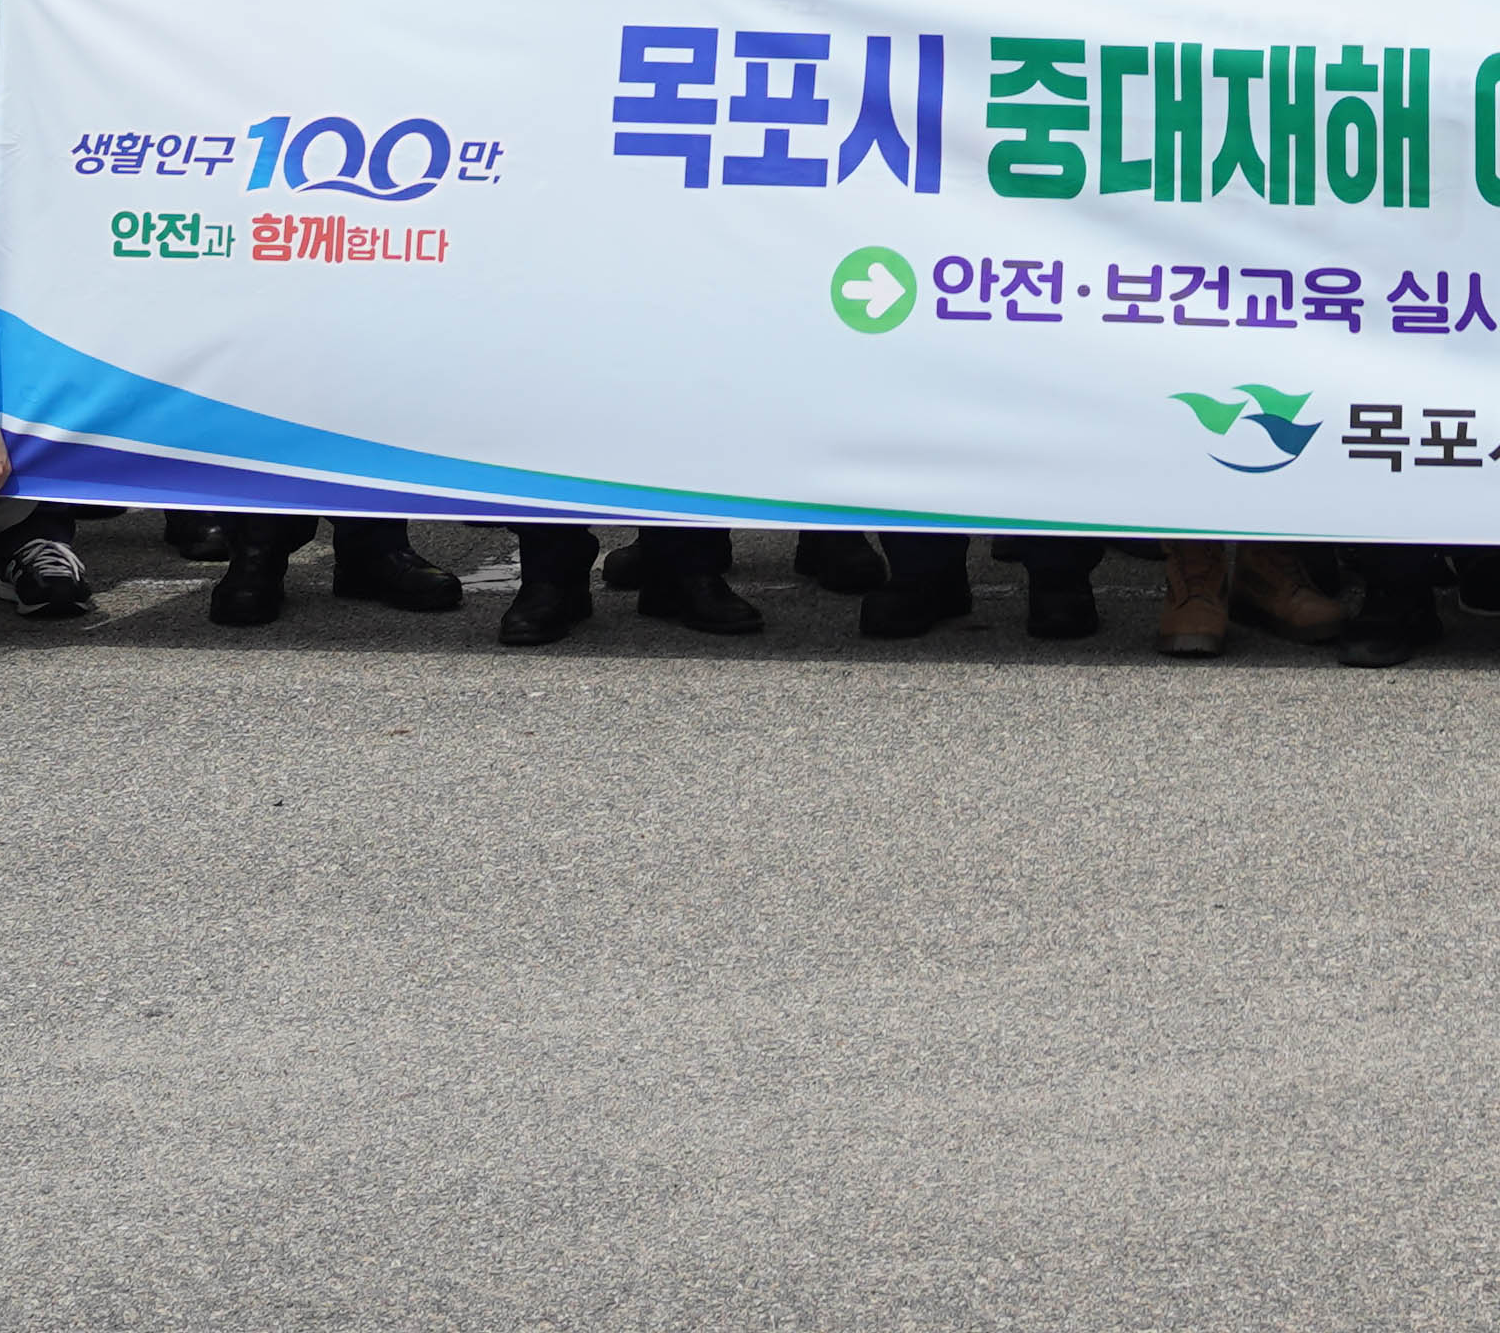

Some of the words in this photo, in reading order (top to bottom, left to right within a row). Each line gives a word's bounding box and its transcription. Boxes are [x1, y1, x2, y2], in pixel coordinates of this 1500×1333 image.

[611, 24, 946, 195] 목포시
[985, 35, 1432, 210] 중대재해
[71, 132, 236, 177] 생활인구
[110, 210, 236, 260] 안전과
[250, 211, 451, 265] 함께합니다
